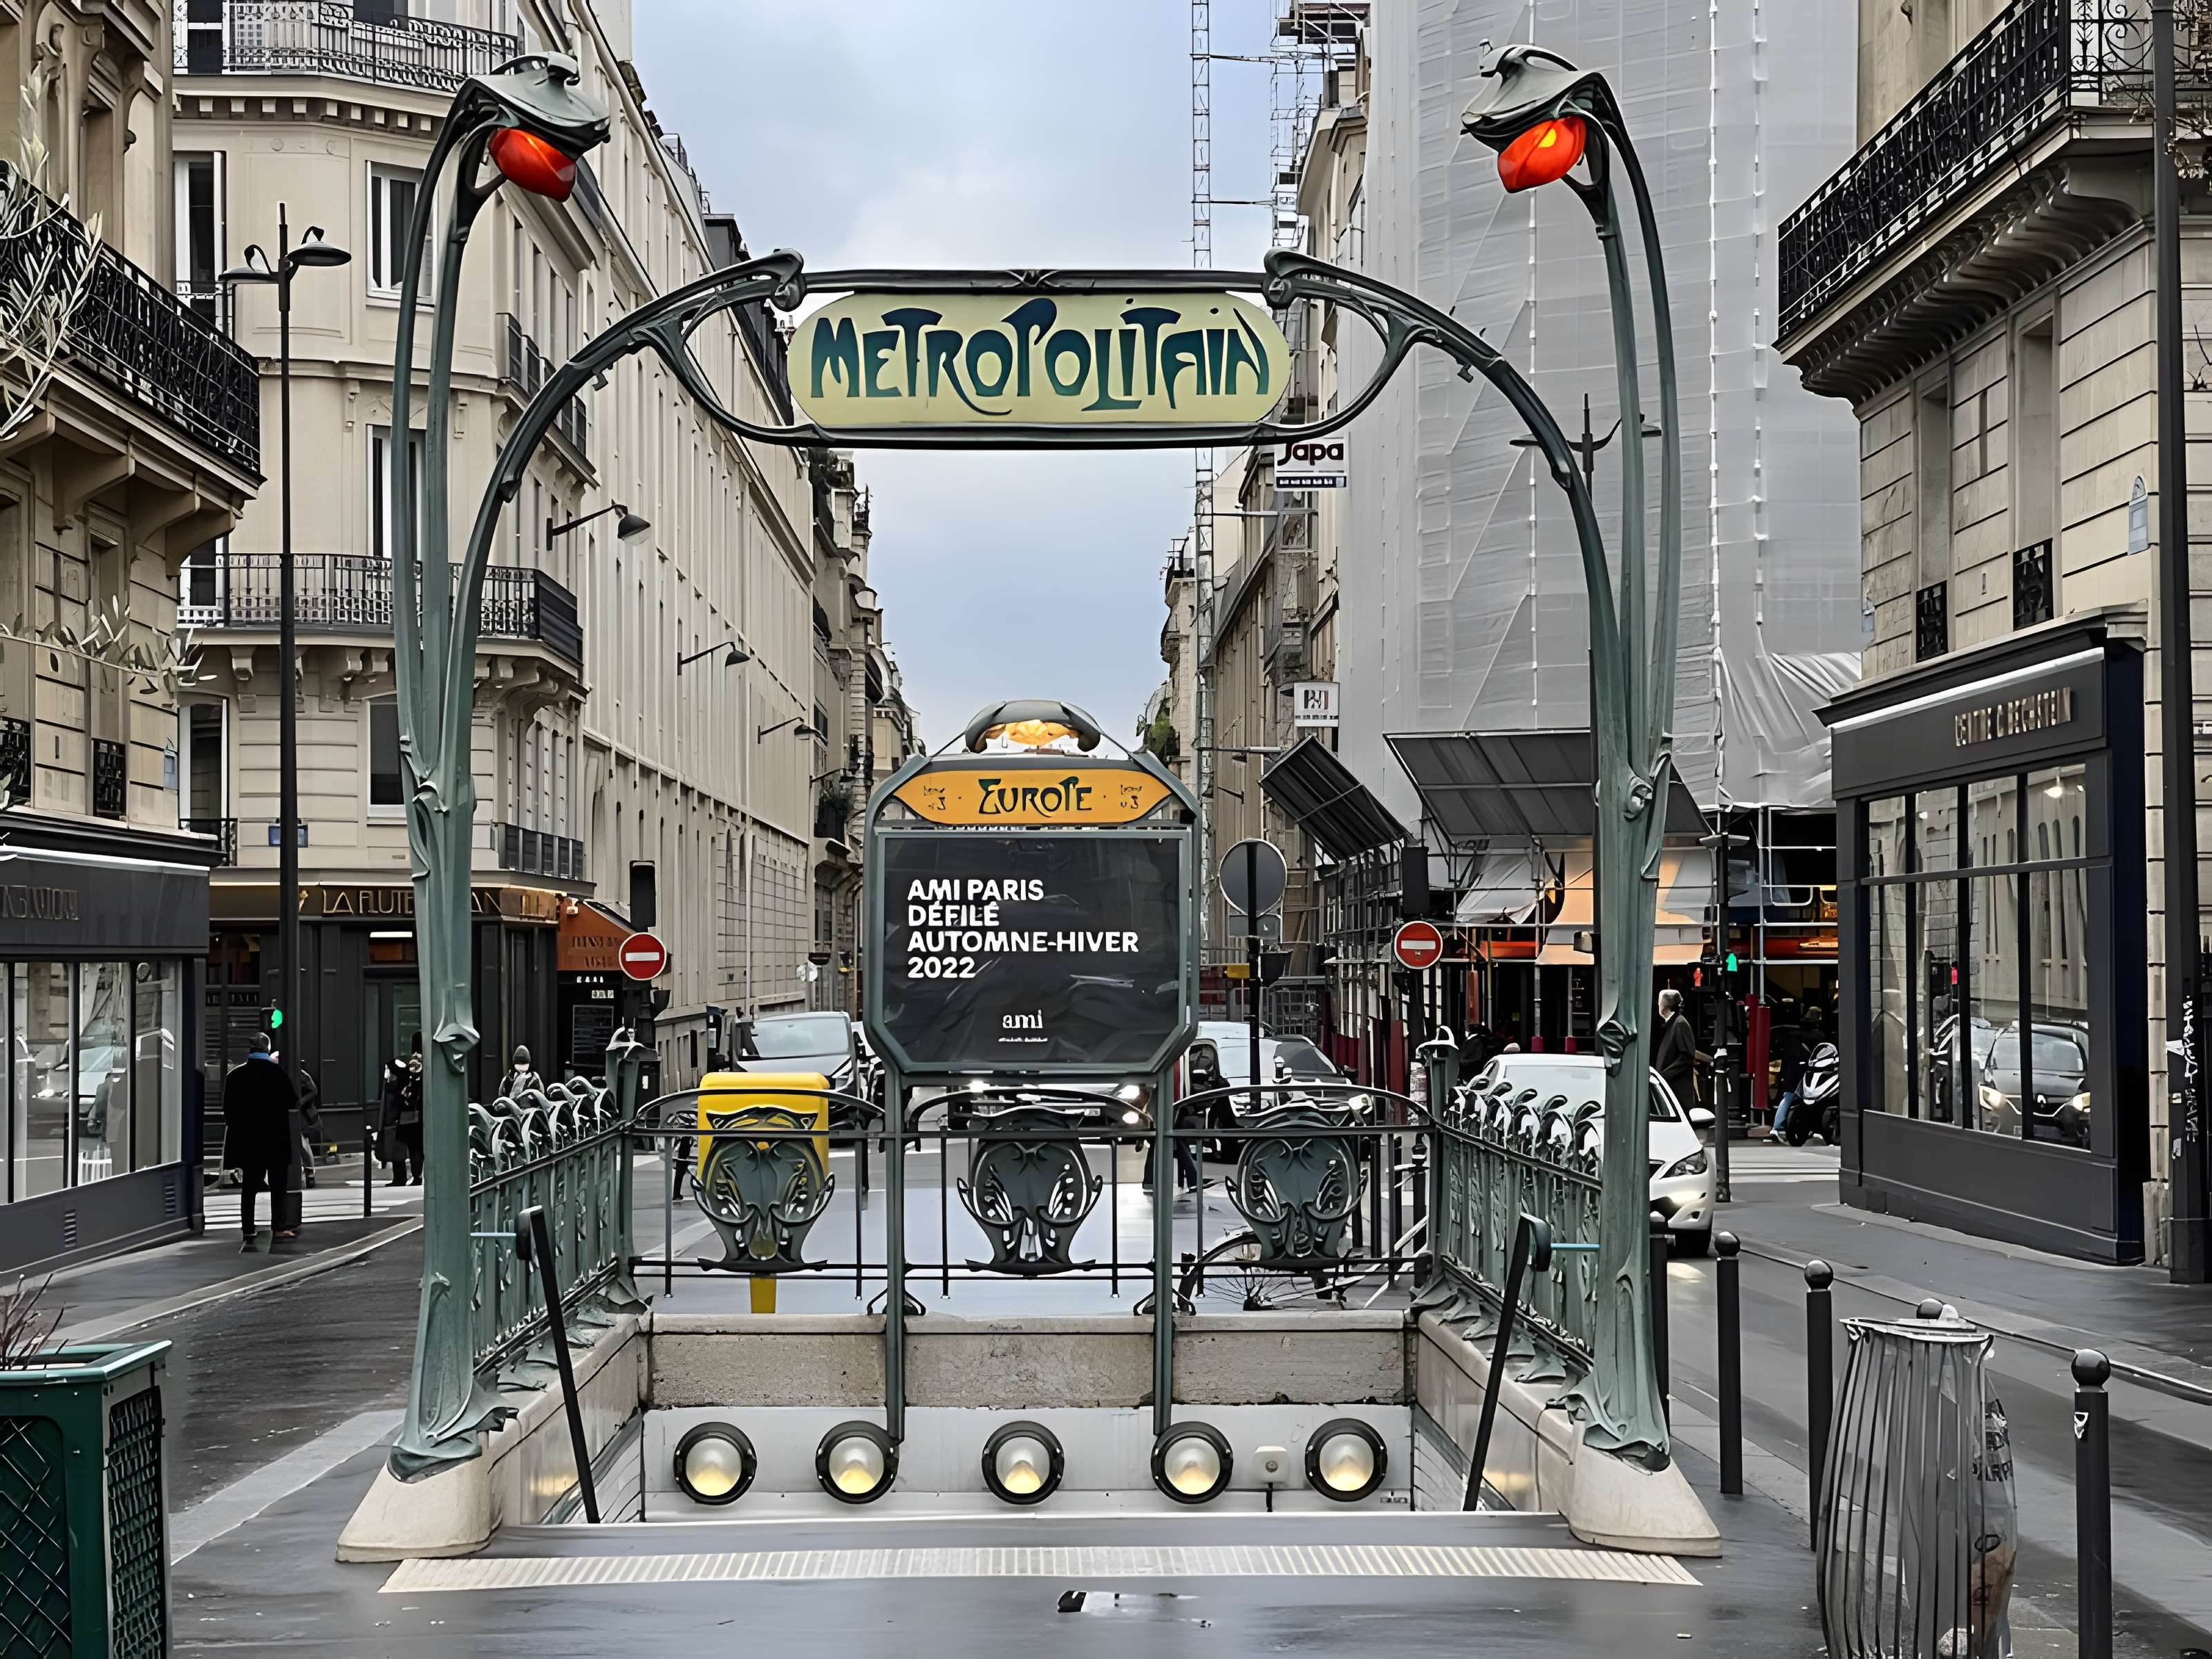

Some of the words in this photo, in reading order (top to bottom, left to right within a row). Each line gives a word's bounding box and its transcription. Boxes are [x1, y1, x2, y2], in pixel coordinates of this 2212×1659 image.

[810, 297, 1269, 415] METROPOLITAIN
[977, 776, 1093, 818] EUROPE
[907, 879, 961, 901] AMI
[967, 879, 1045, 901] PARIS
[322, 890, 354, 915] LA
[907, 930, 1139, 953] AUTOMNE-HIVER
[907, 956, 976, 979] 2022
[1002, 1009, 1043, 1029] ami
